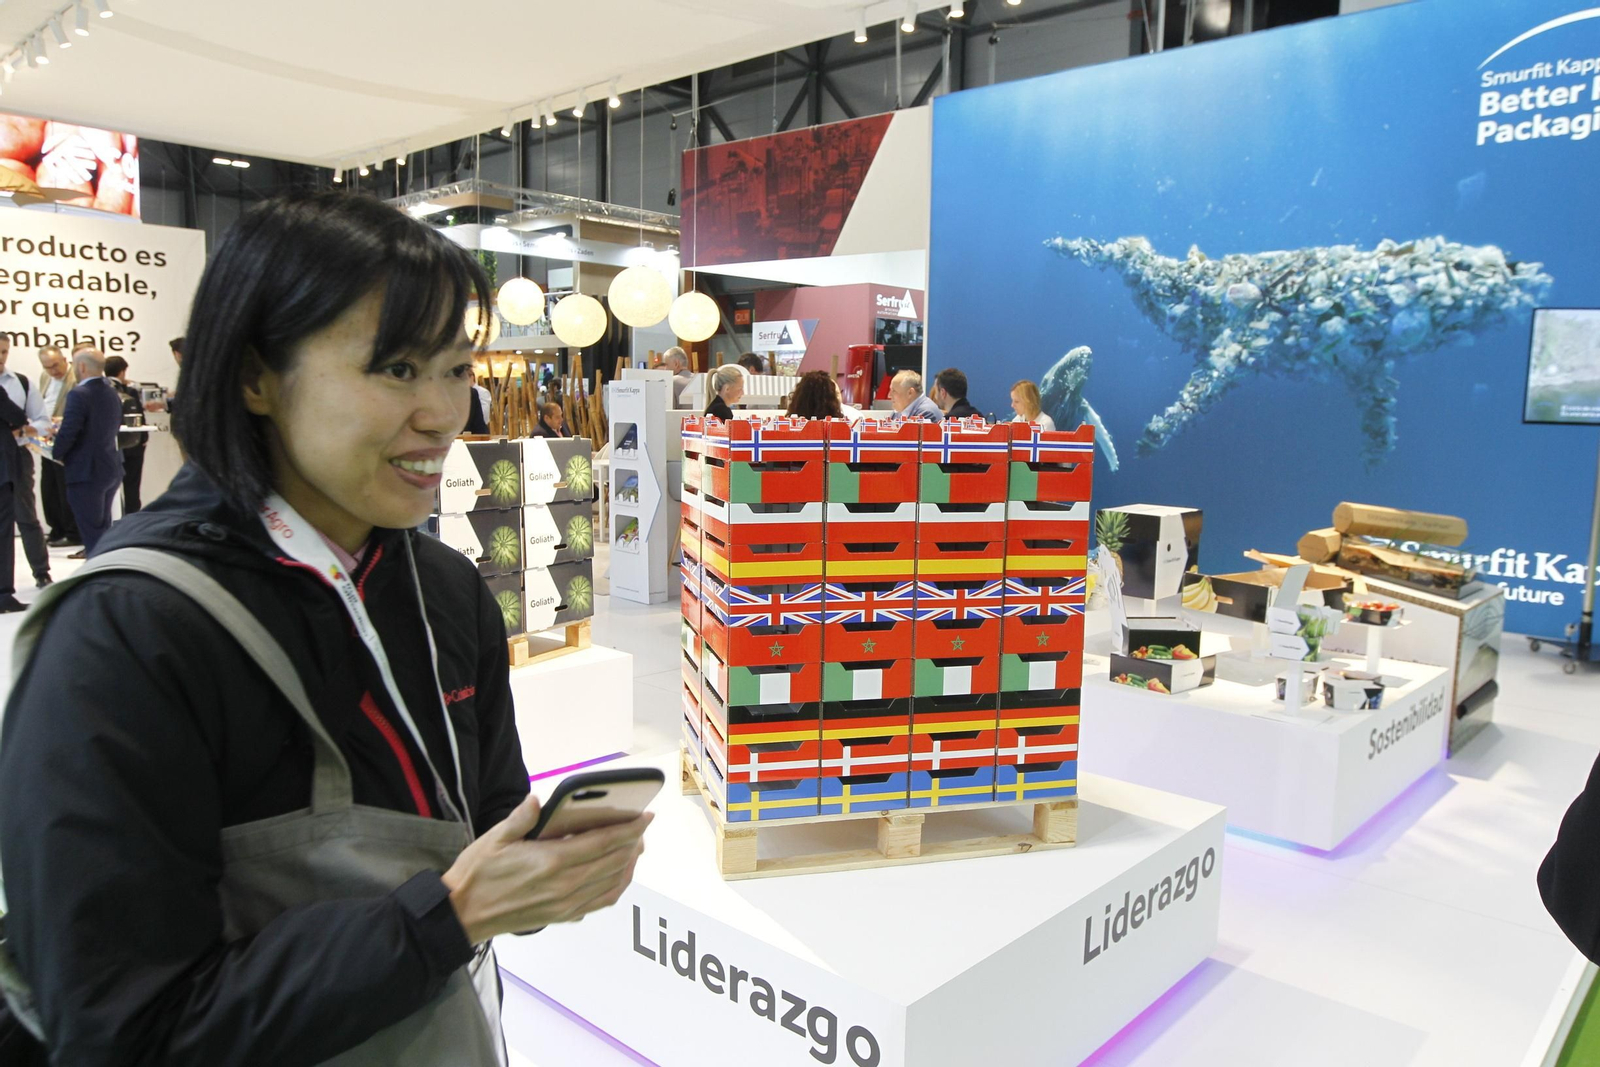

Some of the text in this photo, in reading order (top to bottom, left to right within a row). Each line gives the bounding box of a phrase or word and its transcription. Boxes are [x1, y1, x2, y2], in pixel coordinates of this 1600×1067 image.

[1481, 62, 1554, 88] Smurfit
[1479, 83, 1587, 117] Better
[1476, 105, 1600, 146] Packagi
[136, 250, 167, 267] es
[32, 298, 90, 323] qué
[99, 305, 134, 322] no
[446, 478, 475, 489] Goliath
[529, 473, 554, 482] Goliath
[456, 546, 475, 557] liath
[530, 534, 555, 545] Goliath
[530, 596, 555, 608] Goliath
[1368, 685, 1445, 760] Sostenibilidad
[1083, 846, 1216, 966] Liderazgo
[632, 903, 881, 1067] Liderazgo
